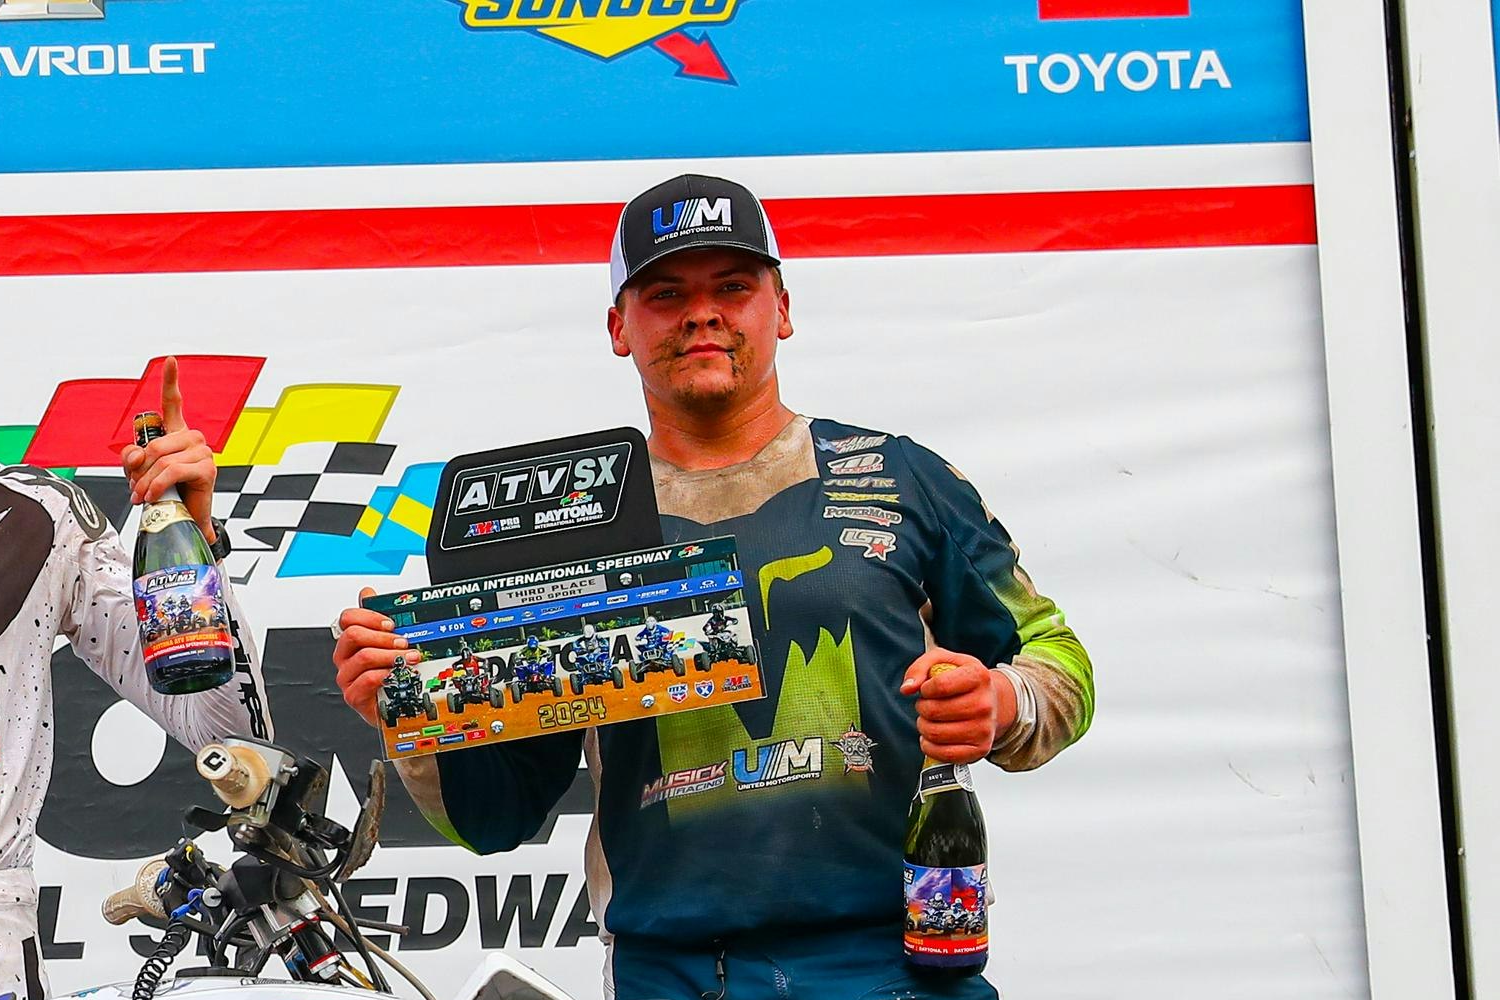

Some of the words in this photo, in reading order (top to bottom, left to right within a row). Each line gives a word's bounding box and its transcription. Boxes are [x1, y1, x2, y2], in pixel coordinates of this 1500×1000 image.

[1005, 50, 1231, 95] TOYOTA
[654, 232, 679, 244] UNITED
[680, 226, 732, 237] MOTORSPORTS
[500, 516, 520, 527] PRO
[534, 502, 603, 524] DAYTONA
[534, 520, 575, 530] INTERNATIONAL
[576, 514, 603, 524] SPEEDWAY
[422, 583, 480, 601] DAYTONA
[483, 565, 592, 589] INTERNATIONAL
[596, 550, 672, 571] SPEEDWAY
[507, 587, 546, 599] THIRD
[551, 579, 596, 591] PLACE
[521, 596, 542, 604] PRO
[548, 589, 583, 599] SPORT
[449, 622, 464, 631] FOX
[538, 696, 607, 729] 2024
[643, 761, 728, 797] MUSICK
[676, 777, 724, 796] RACING
[737, 781, 765, 791] UNITED
[766, 771, 820, 786] MOTORSPORTS
